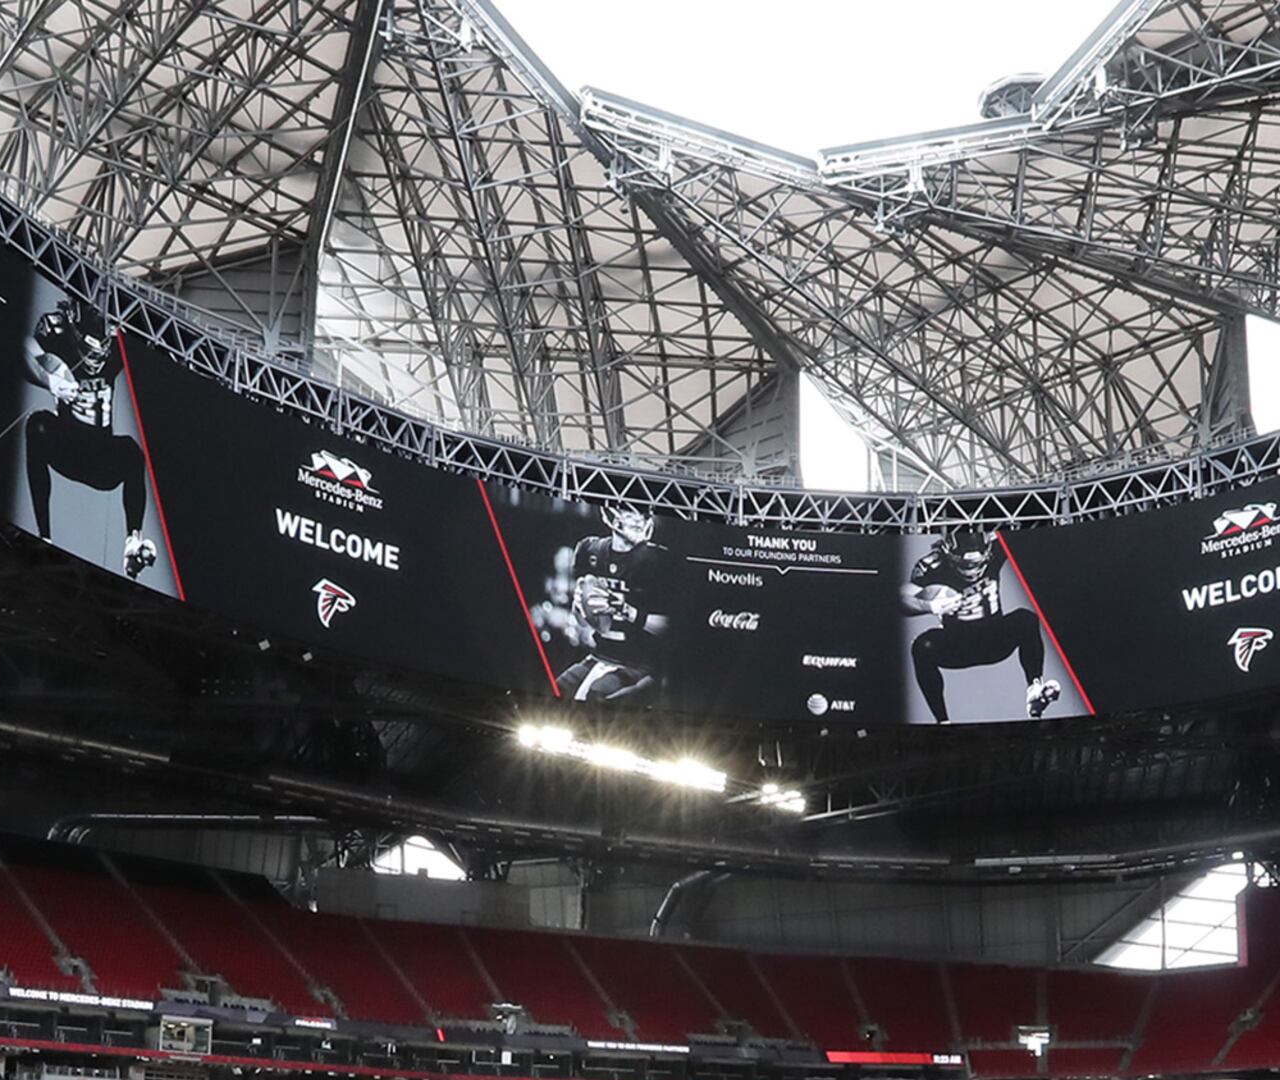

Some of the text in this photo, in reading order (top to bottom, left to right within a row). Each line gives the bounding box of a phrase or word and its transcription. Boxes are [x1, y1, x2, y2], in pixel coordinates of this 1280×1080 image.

[297, 468, 383, 509] Mercedes-Benz
[315, 490, 364, 512] STADIUM
[275, 508, 400, 570] WELCOME
[747, 535, 817, 551] THANK YOU
[723, 547, 841, 564] TO OUR FOUNDING PARTNERS
[1221, 538, 1272, 558] STADIUM
[708, 569, 763, 587] Novelis
[802, 654, 857, 668] EQUIFAX
[830, 700, 855, 711] AT&T
[8, 987, 47, 1000] WELCOME
[48, 991, 59, 1001] TO
